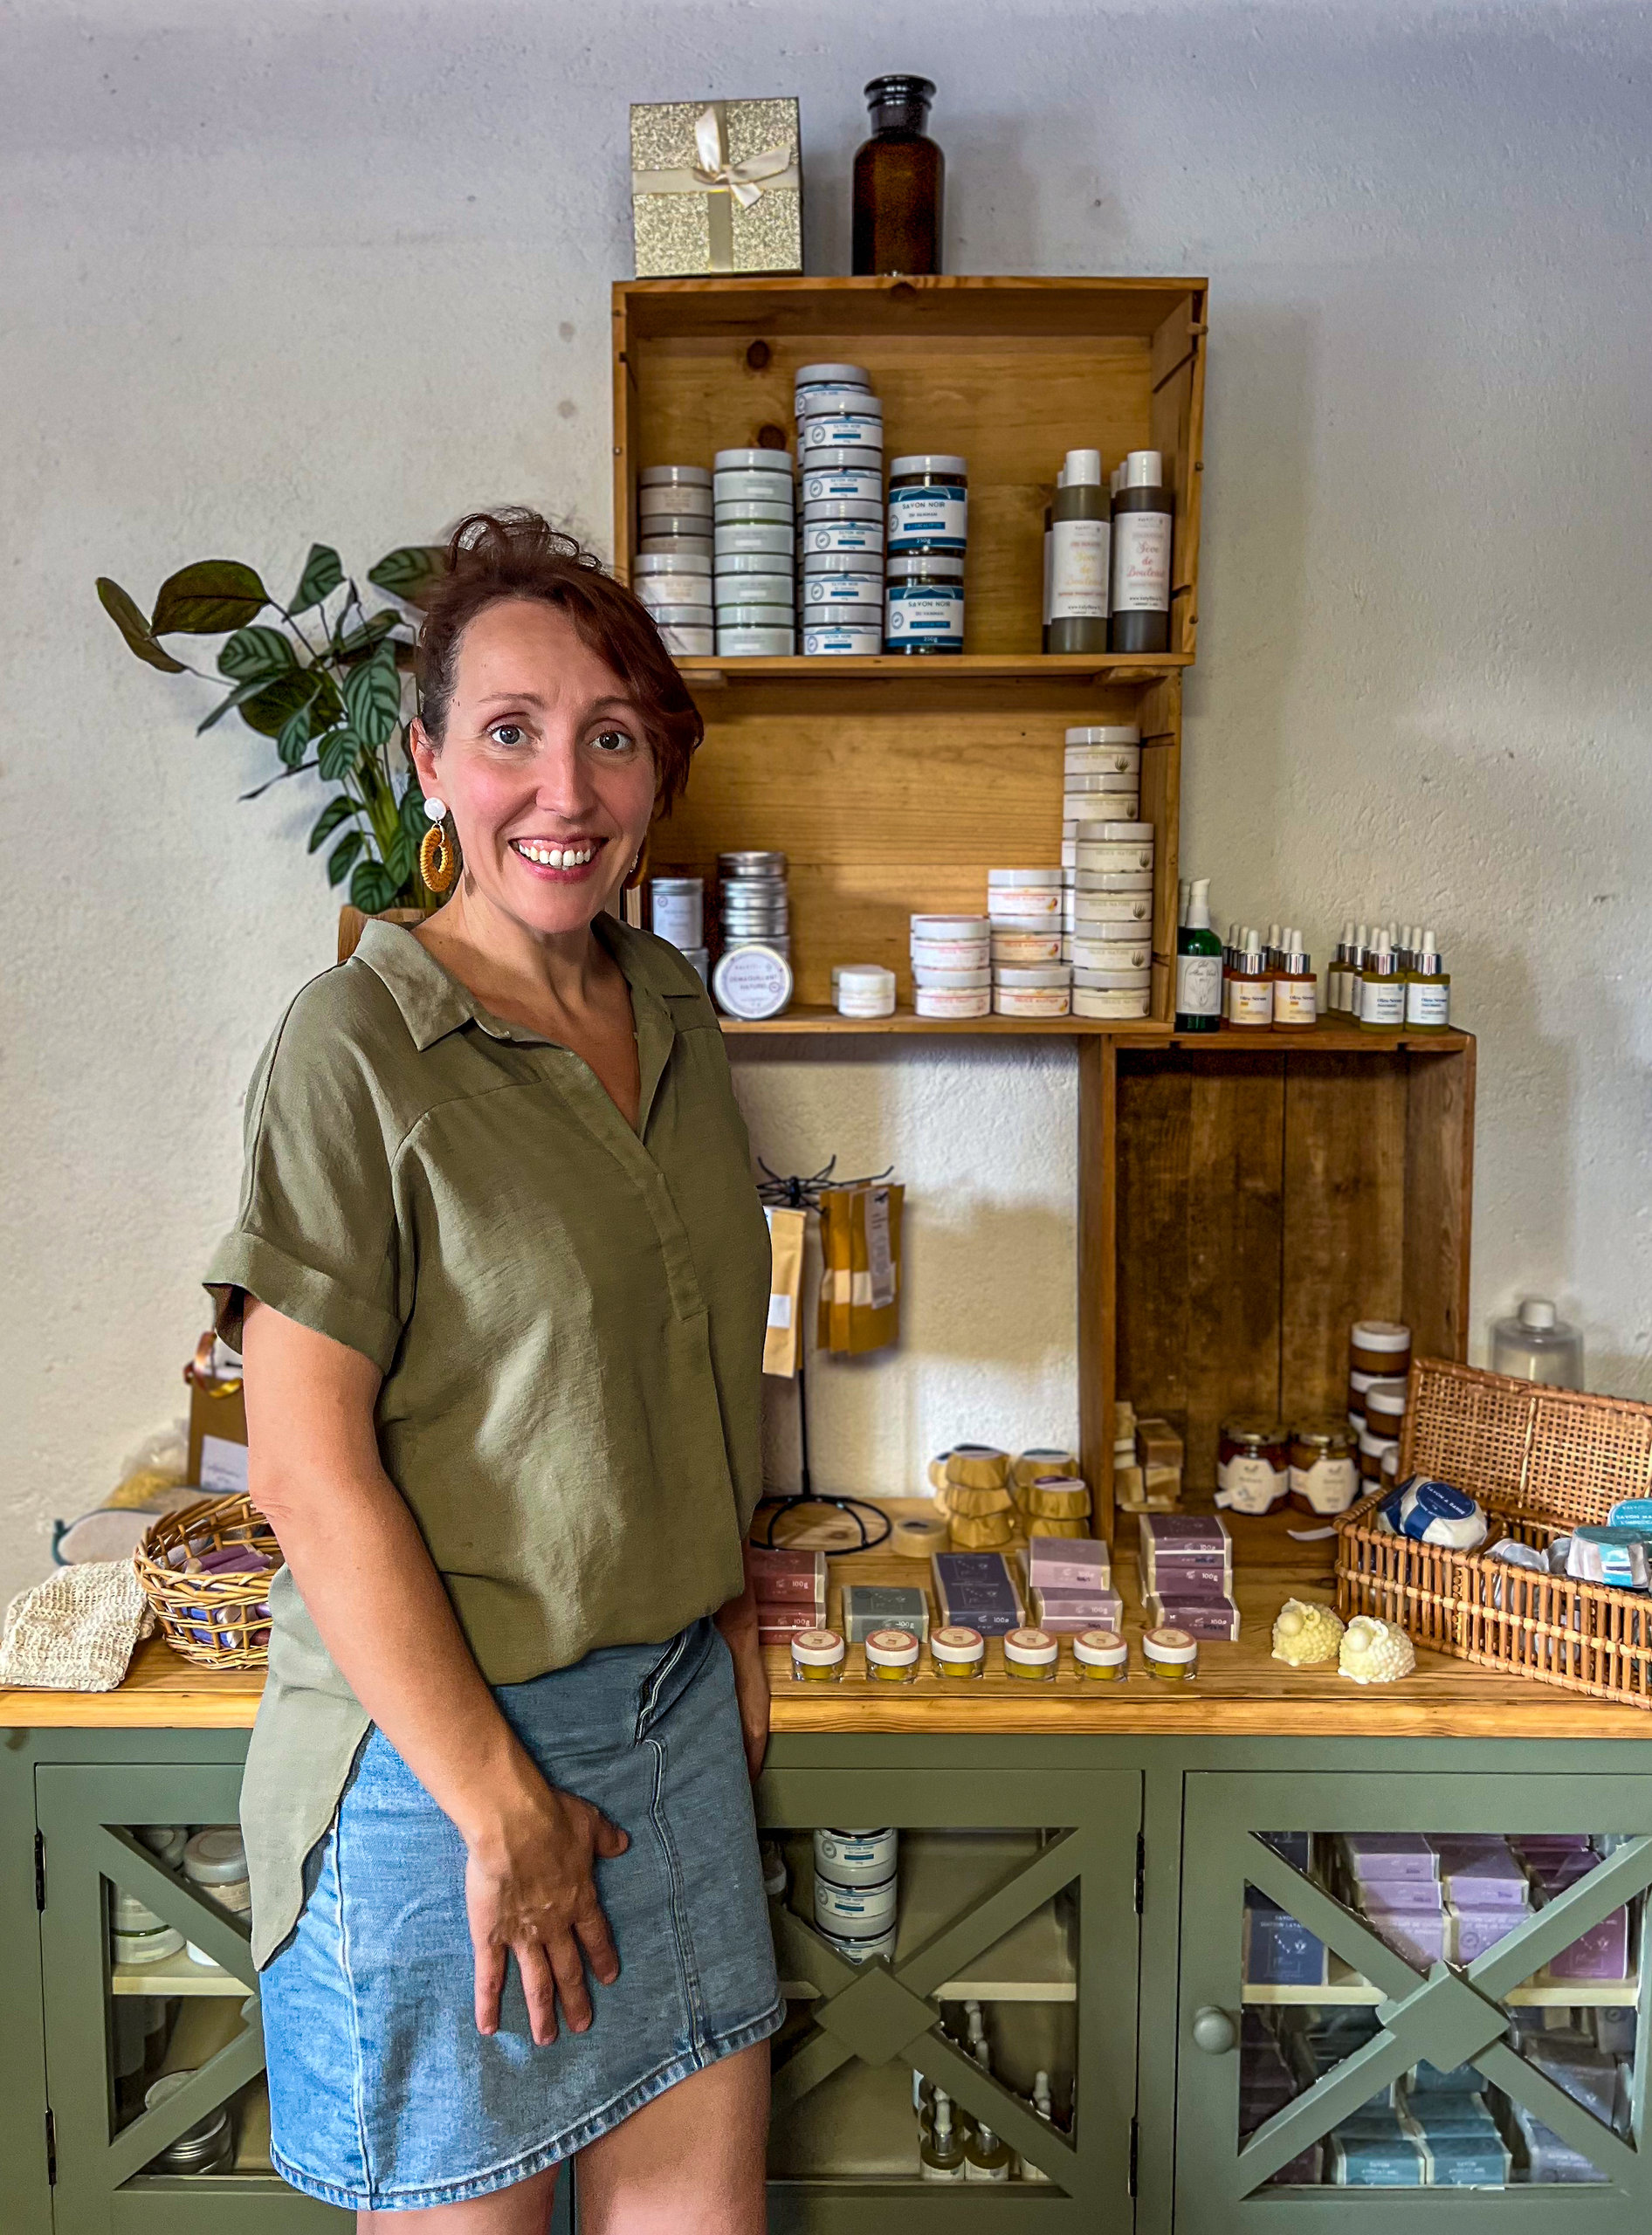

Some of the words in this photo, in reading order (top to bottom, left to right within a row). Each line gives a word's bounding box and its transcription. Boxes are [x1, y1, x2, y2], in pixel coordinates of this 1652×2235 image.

[902, 501, 926, 510] SAVON
[1426, 1485, 1445, 1500] SAVON
[1201, 1571, 1219, 1582] 100g
[792, 1580, 809, 1589] 100g
[1091, 1606, 1108, 1615] 100g
[793, 1618, 810, 1627] 100g
